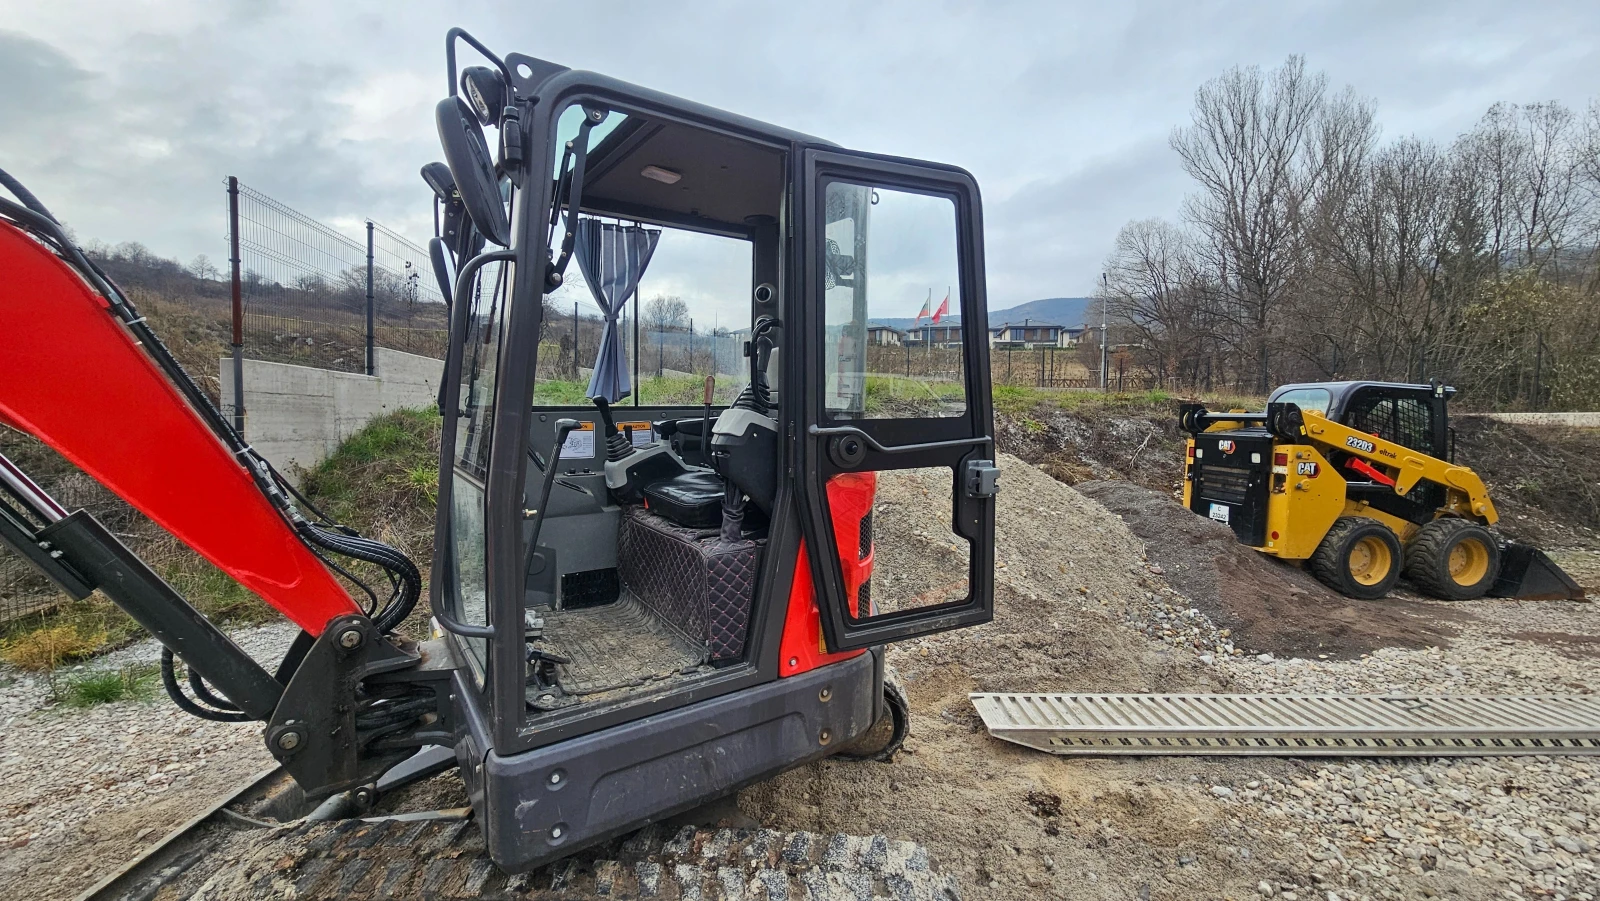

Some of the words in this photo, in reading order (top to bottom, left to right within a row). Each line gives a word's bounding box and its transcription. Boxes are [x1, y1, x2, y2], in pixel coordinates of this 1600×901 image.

[1218, 440, 1232, 451] CAT
[1346, 436, 1373, 453] 232D3
[1298, 462, 1317, 475] CAT
